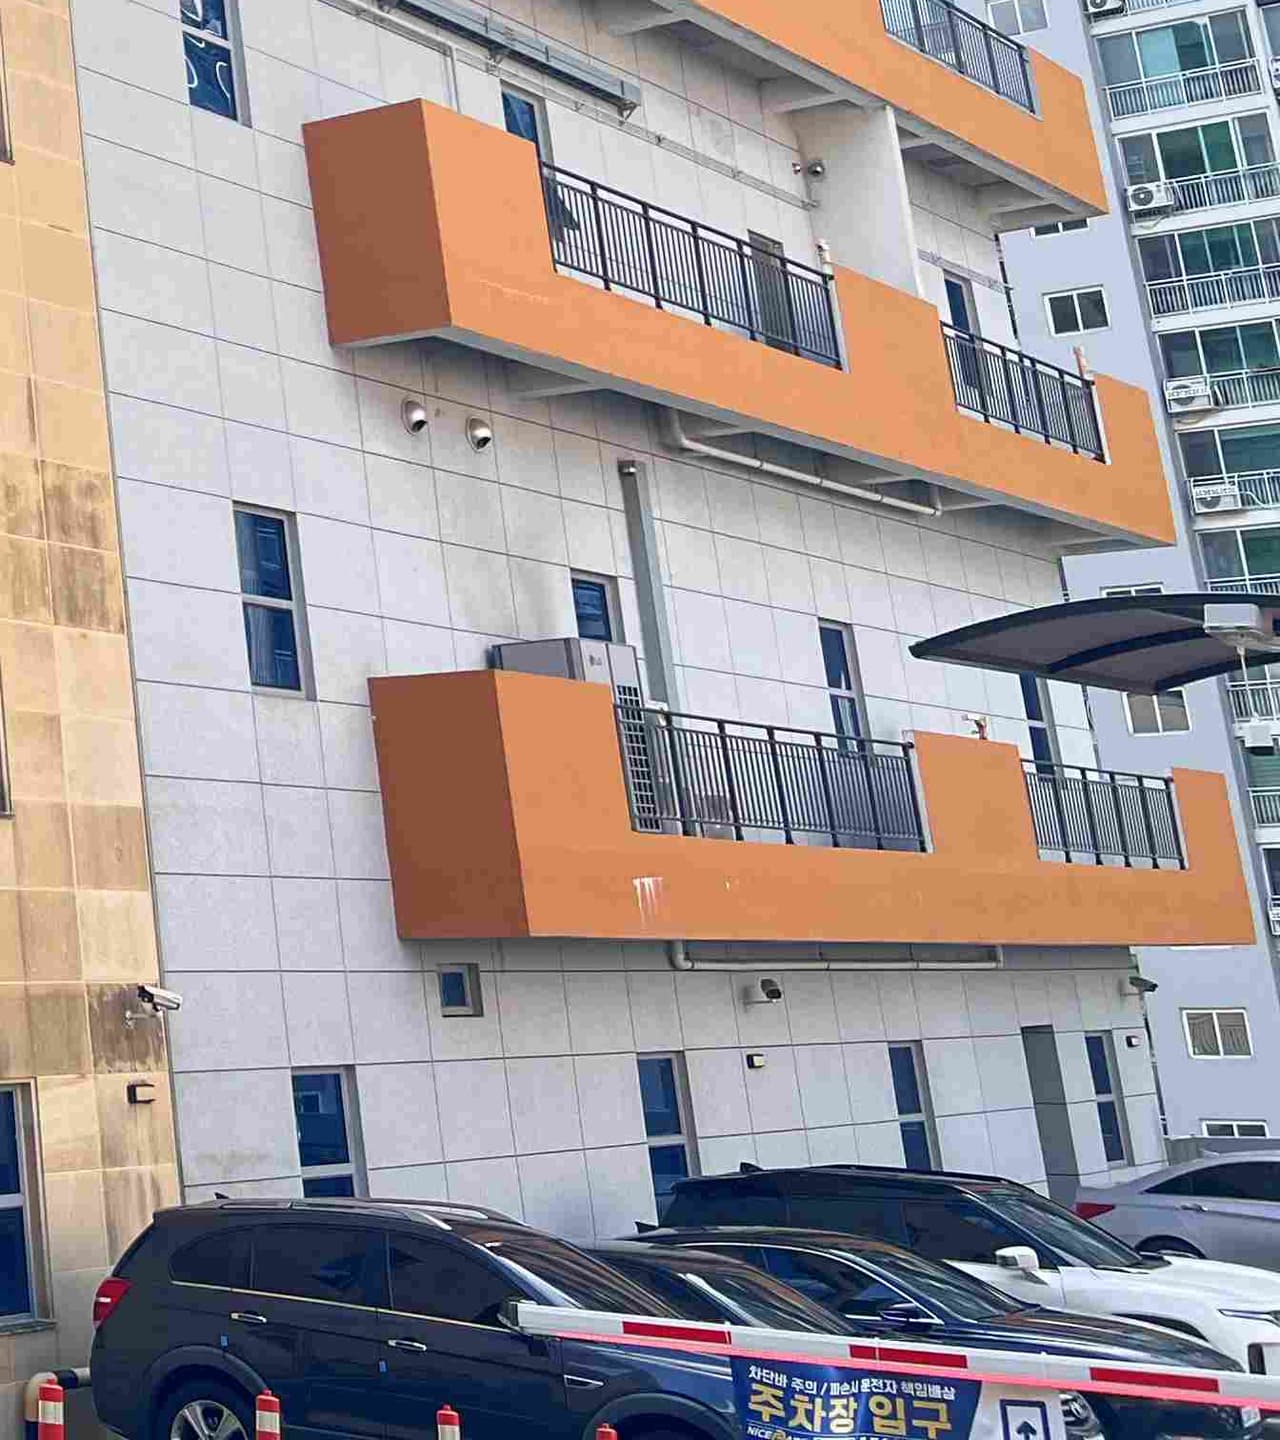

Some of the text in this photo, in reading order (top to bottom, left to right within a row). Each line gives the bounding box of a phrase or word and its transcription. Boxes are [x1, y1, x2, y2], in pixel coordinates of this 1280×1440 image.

[748, 1365, 787, 1388] 차단바
[791, 1377, 817, 1395] 주의
[860, 1378, 897, 1394] 운전자
[901, 1381, 956, 1400] 책임배상
[748, 1383, 953, 1440] 주차장 입구
